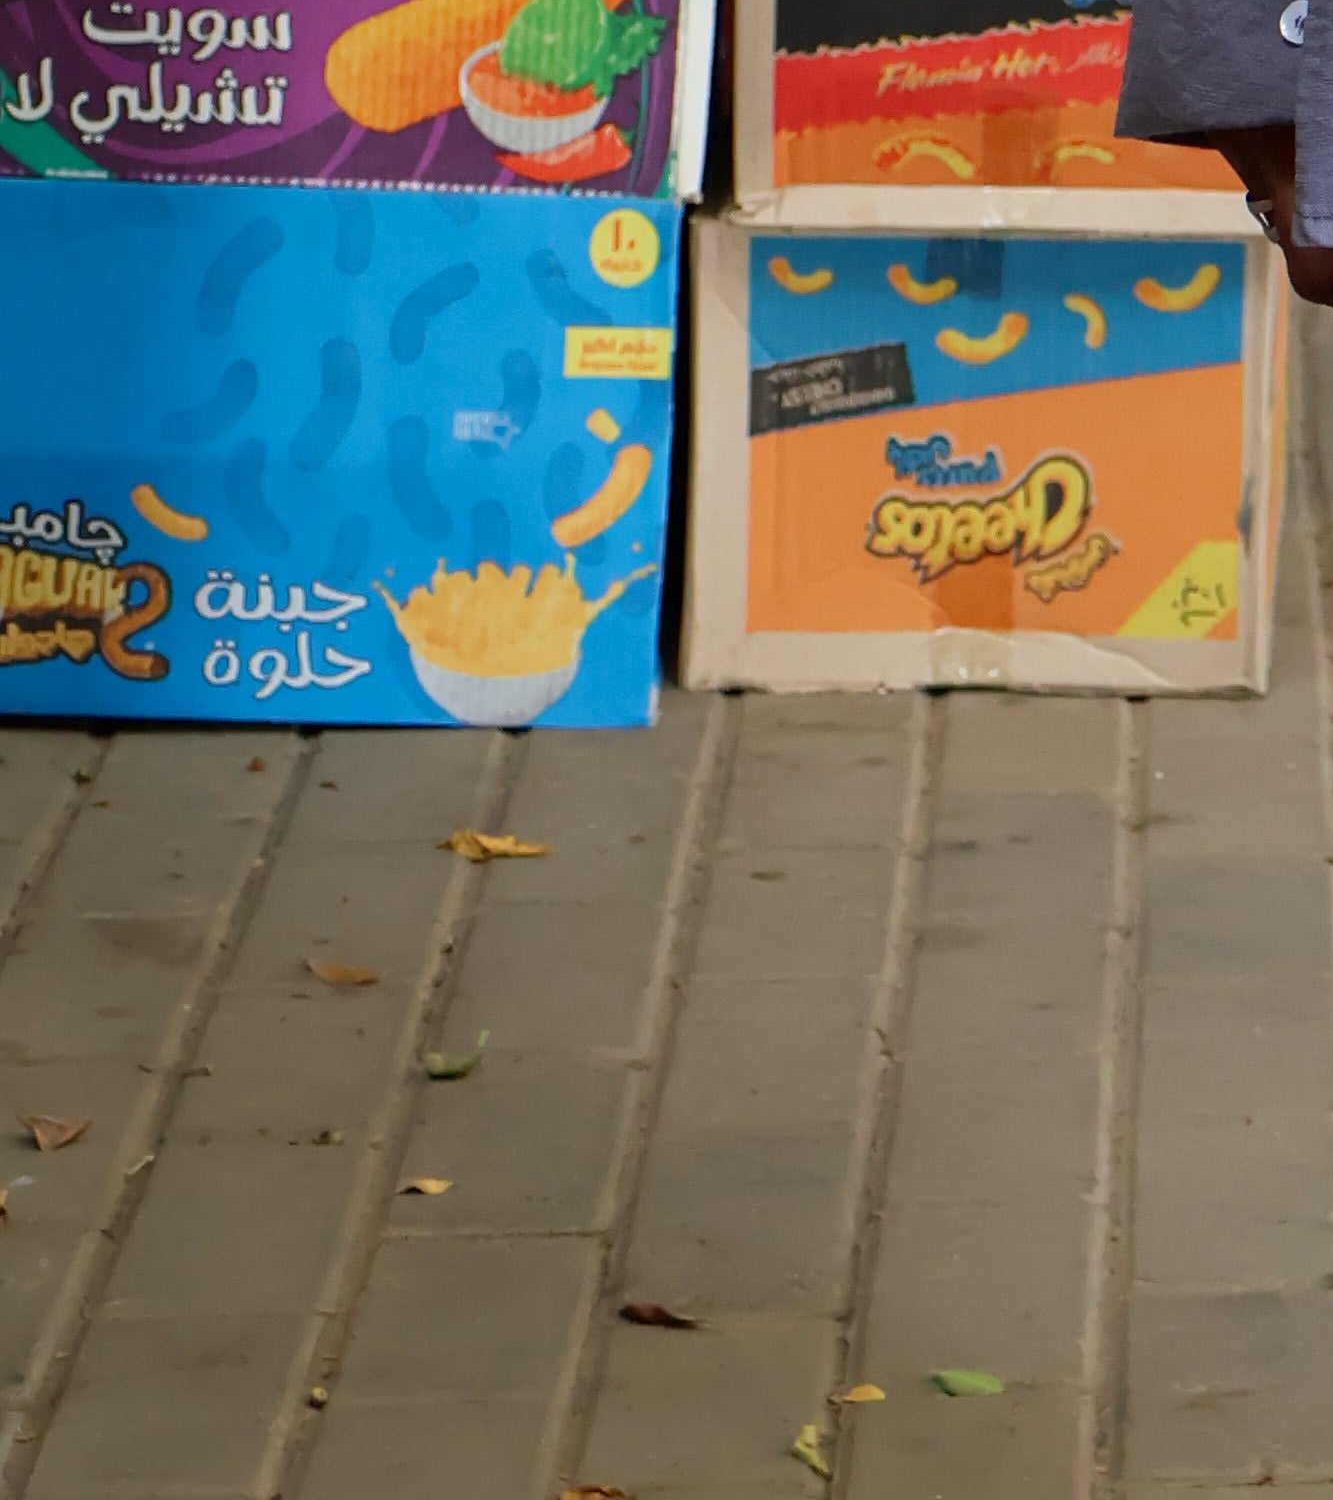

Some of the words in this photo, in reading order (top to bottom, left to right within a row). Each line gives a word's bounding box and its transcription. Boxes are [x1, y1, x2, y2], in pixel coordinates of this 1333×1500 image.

[82, 2, 293, 60] سويت
[70, 60, 287, 144] تشيلي
[0, 499, 126, 566] چامب
[867, 453, 1091, 582] Cheetos
[194, 568, 367, 634] جبنة
[203, 630, 373, 700] حلوة
